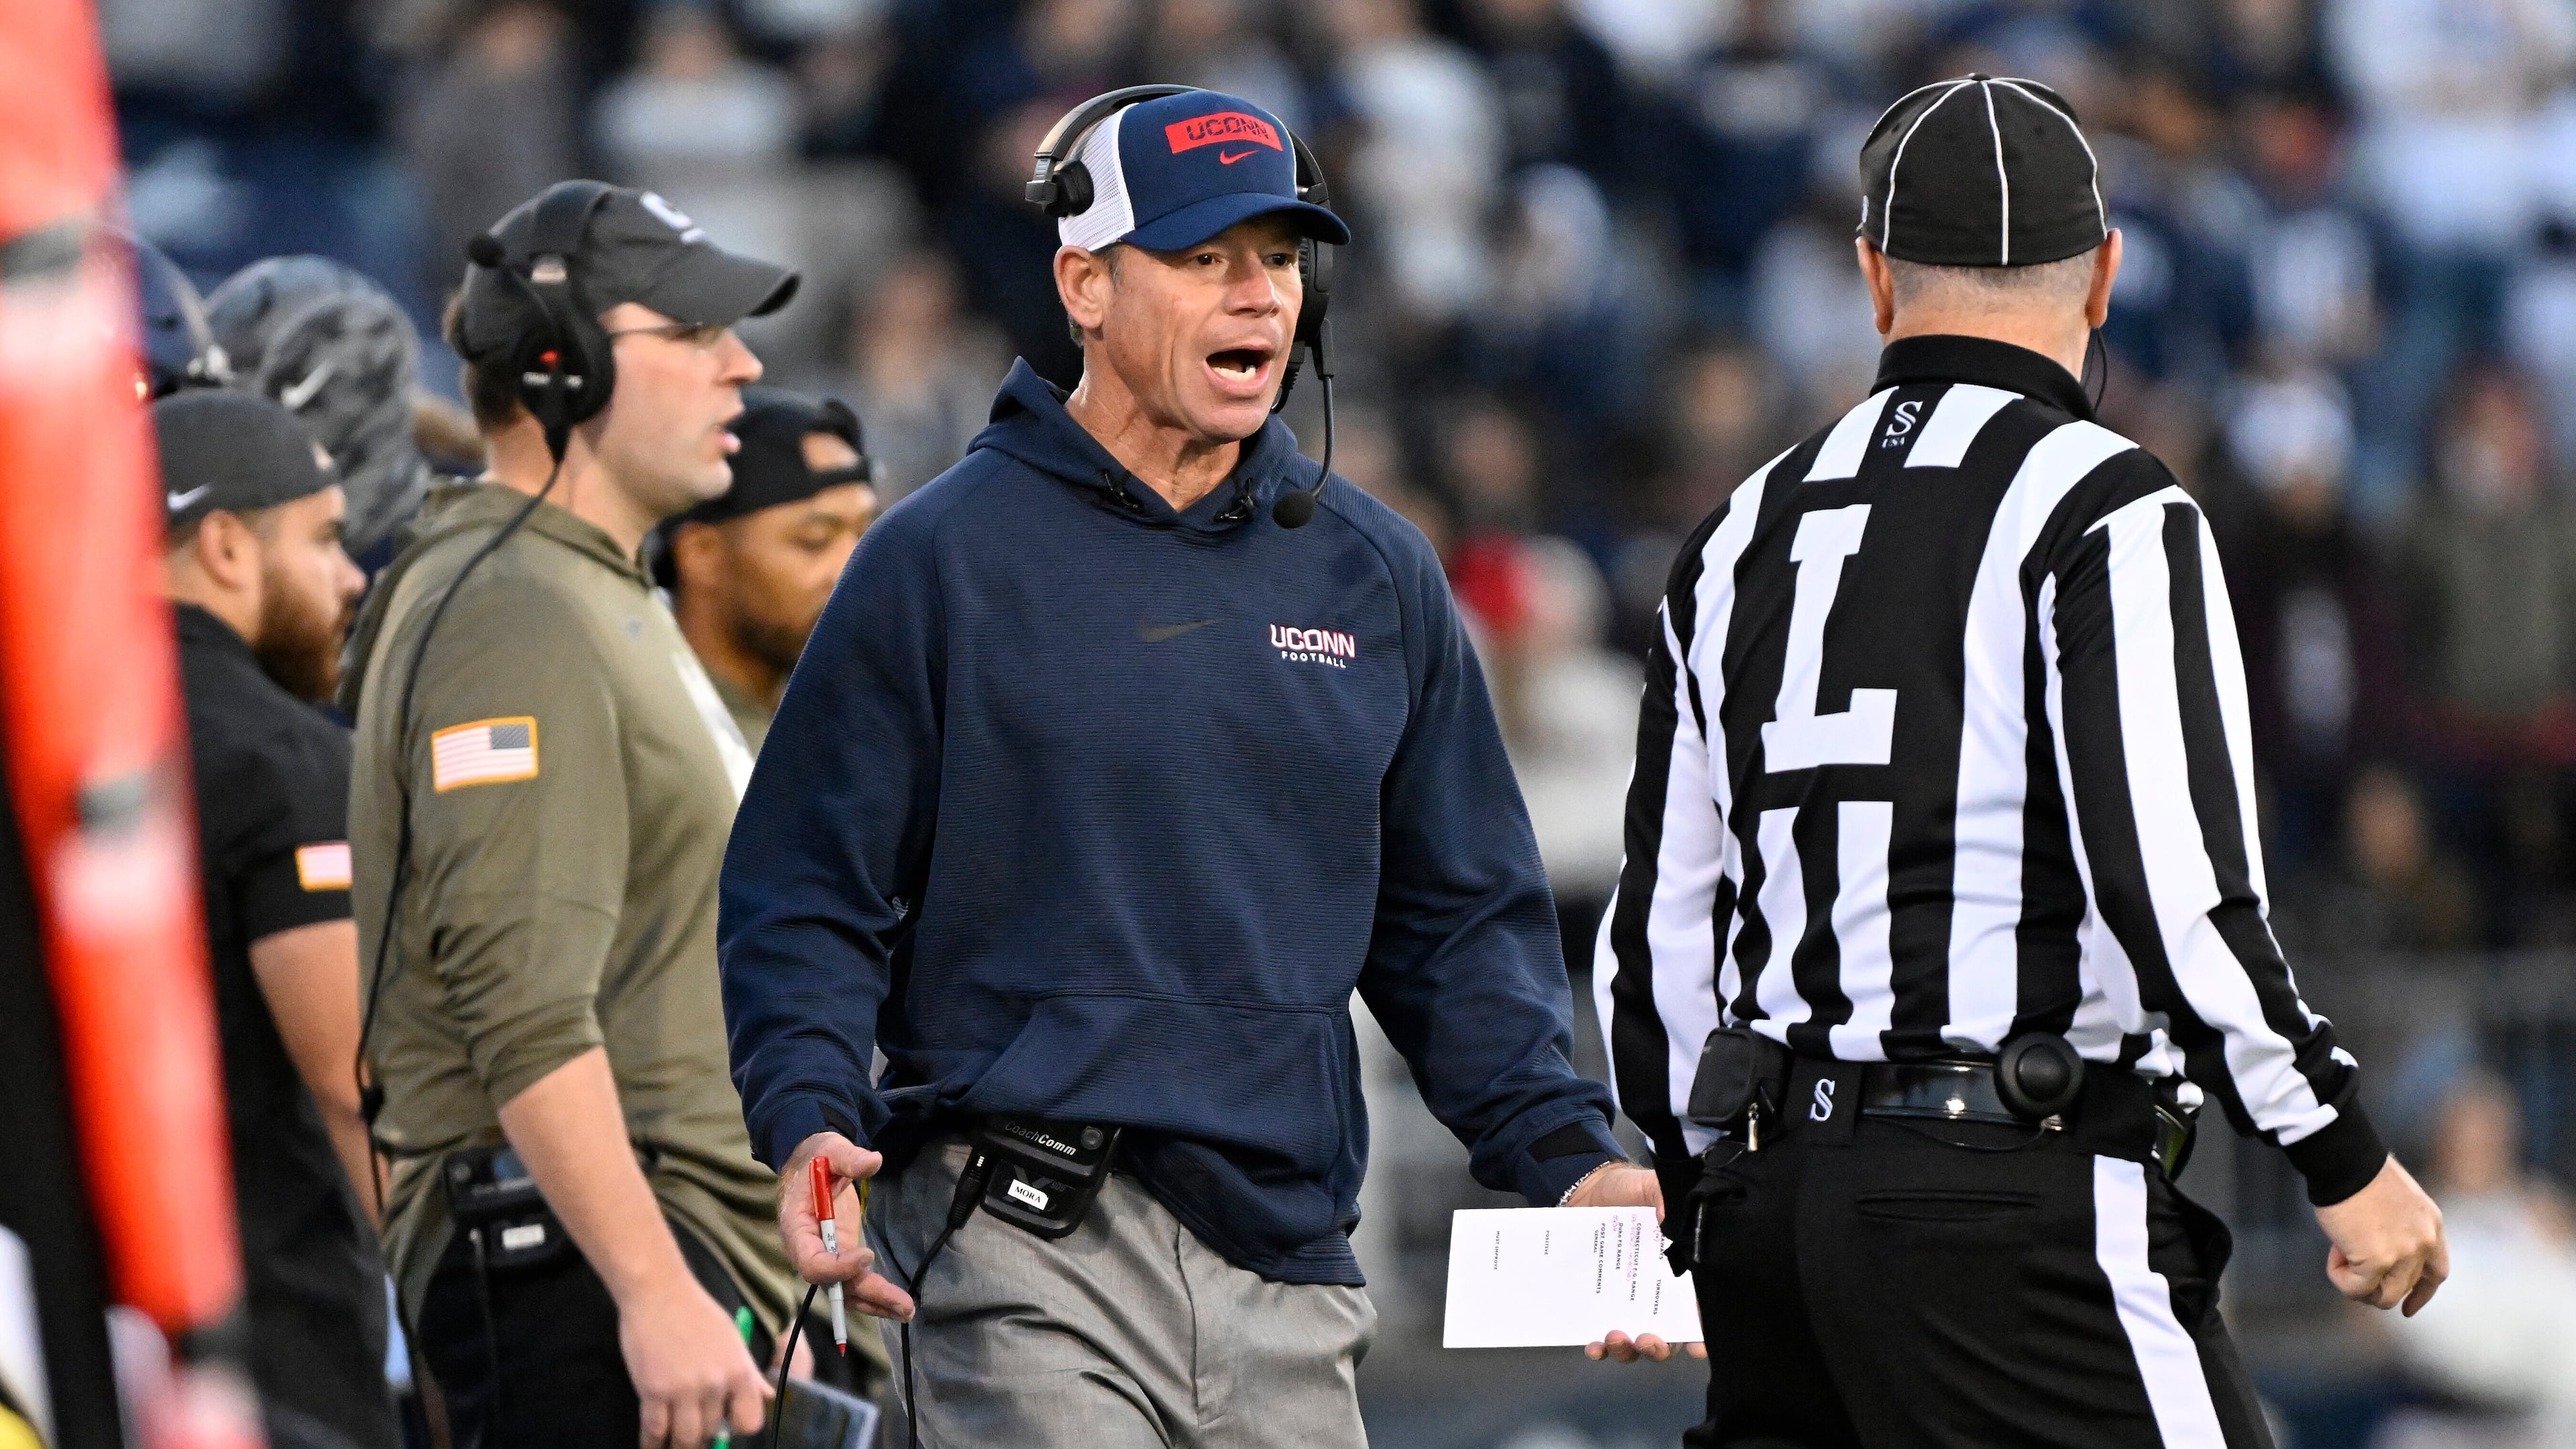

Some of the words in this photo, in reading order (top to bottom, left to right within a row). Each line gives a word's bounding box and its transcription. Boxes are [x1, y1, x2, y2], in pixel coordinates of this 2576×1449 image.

[1187, 117, 1269, 140] UCONN
[1270, 623, 1356, 659] UCONN
[1761, 504, 1898, 774] L
[1281, 651, 1346, 668] FOOTBALL
[1005, 1121, 1077, 1156] CoachComm
[1015, 1185, 1041, 1203] MORA
[1653, 1279, 1661, 1315] TURNOVERS
